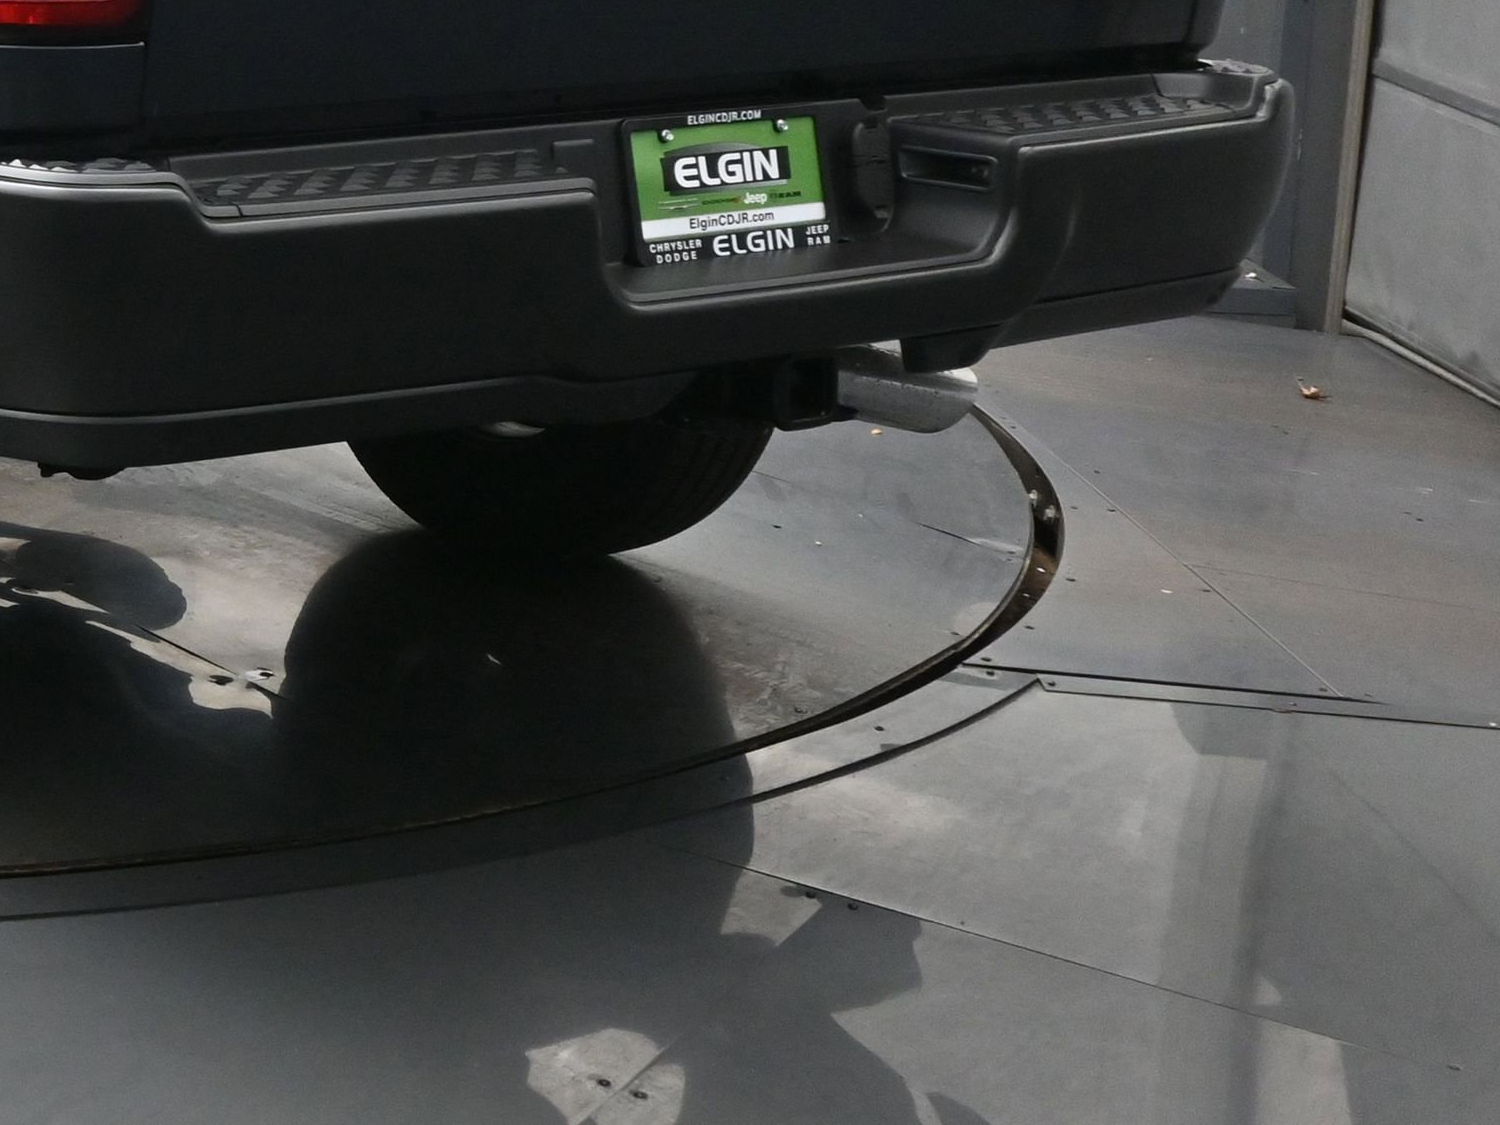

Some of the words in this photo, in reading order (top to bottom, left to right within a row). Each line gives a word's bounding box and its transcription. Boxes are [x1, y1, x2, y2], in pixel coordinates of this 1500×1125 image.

[687, 109, 762, 125] ELGINCDJR.COM
[674, 150, 780, 188] ELGIN
[743, 192, 768, 205] Jeep
[689, 211, 775, 231] ElginCDJR.com
[805, 224, 830, 236] JEEP
[649, 238, 702, 254] CHRYSLER
[713, 228, 794, 256] ELGIN
[806, 234, 831, 246] RAM
[655, 250, 698, 265] DODGE
